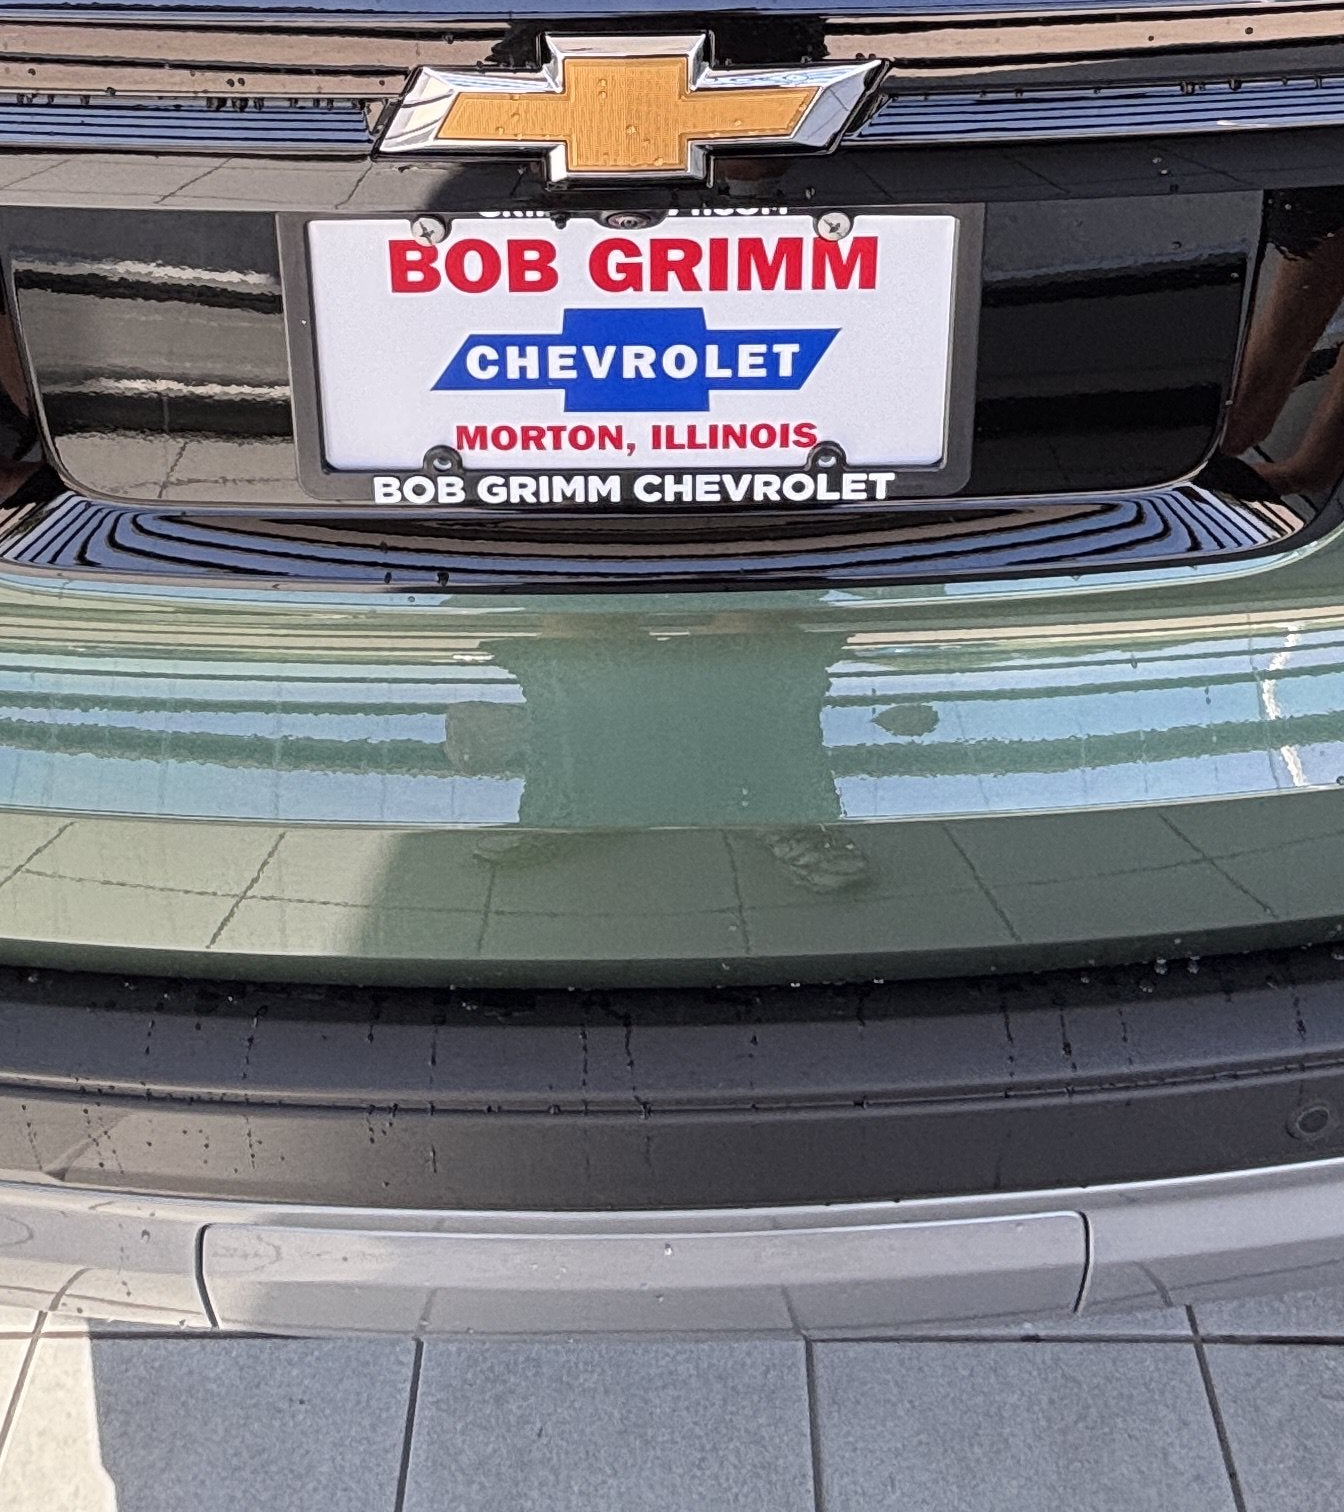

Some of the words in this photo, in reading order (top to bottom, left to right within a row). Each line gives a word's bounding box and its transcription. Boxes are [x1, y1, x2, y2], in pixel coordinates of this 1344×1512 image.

[388, 238, 559, 294] BOB
[588, 235, 879, 292] GRIMM
[465, 343, 800, 380] CHEVROLET
[455, 424, 636, 457] MORTON,
[651, 422, 818, 451] ILLINOIS
[373, 475, 467, 505] BOB
[477, 475, 622, 504] GRIMM
[633, 472, 896, 503] CHEVROLET
